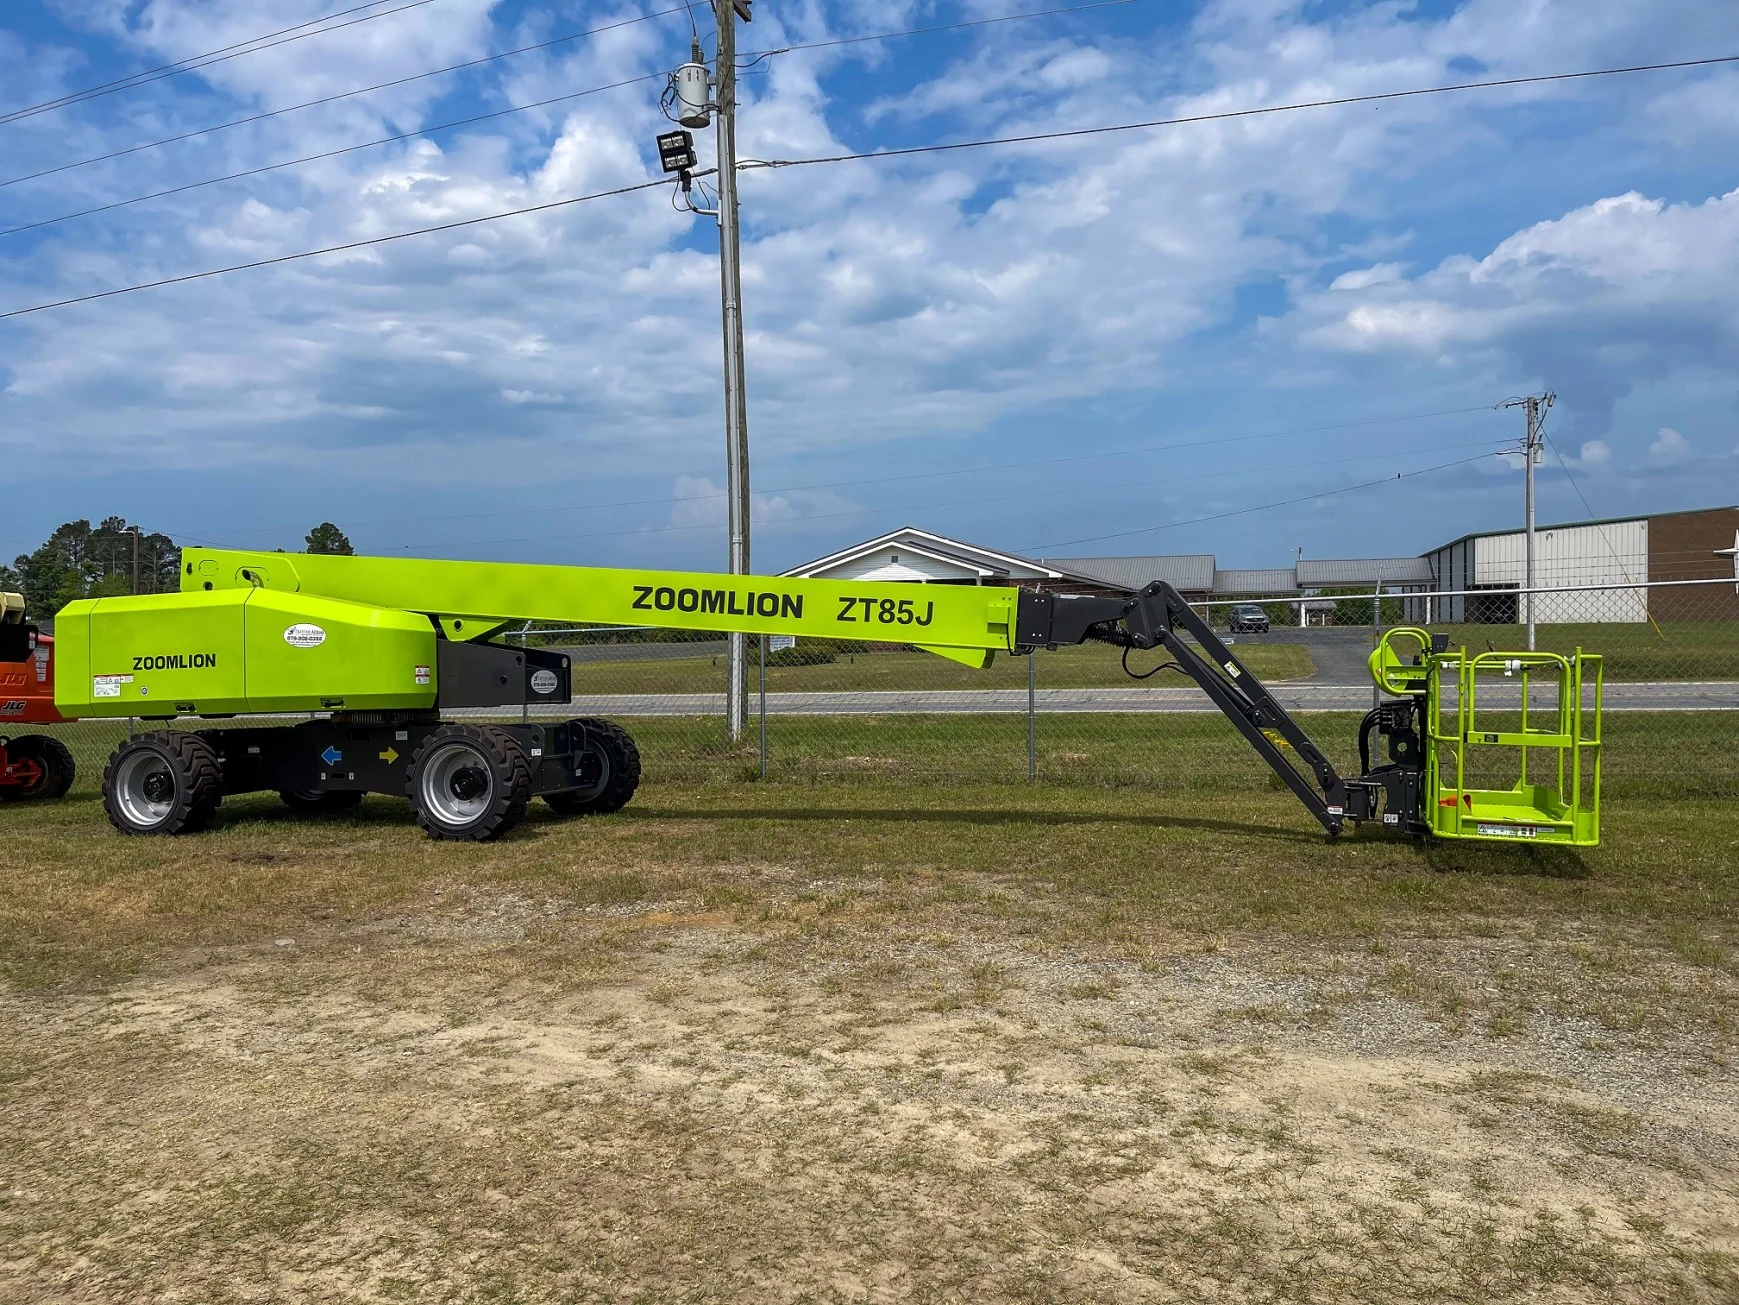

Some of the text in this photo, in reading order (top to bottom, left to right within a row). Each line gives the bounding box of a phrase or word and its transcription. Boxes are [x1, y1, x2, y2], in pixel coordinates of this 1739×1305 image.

[632, 586, 934, 626] ZOOMLION ZT85J
[132, 653, 216, 671] ZOOMLION
[2, 701, 27, 710] JLG
